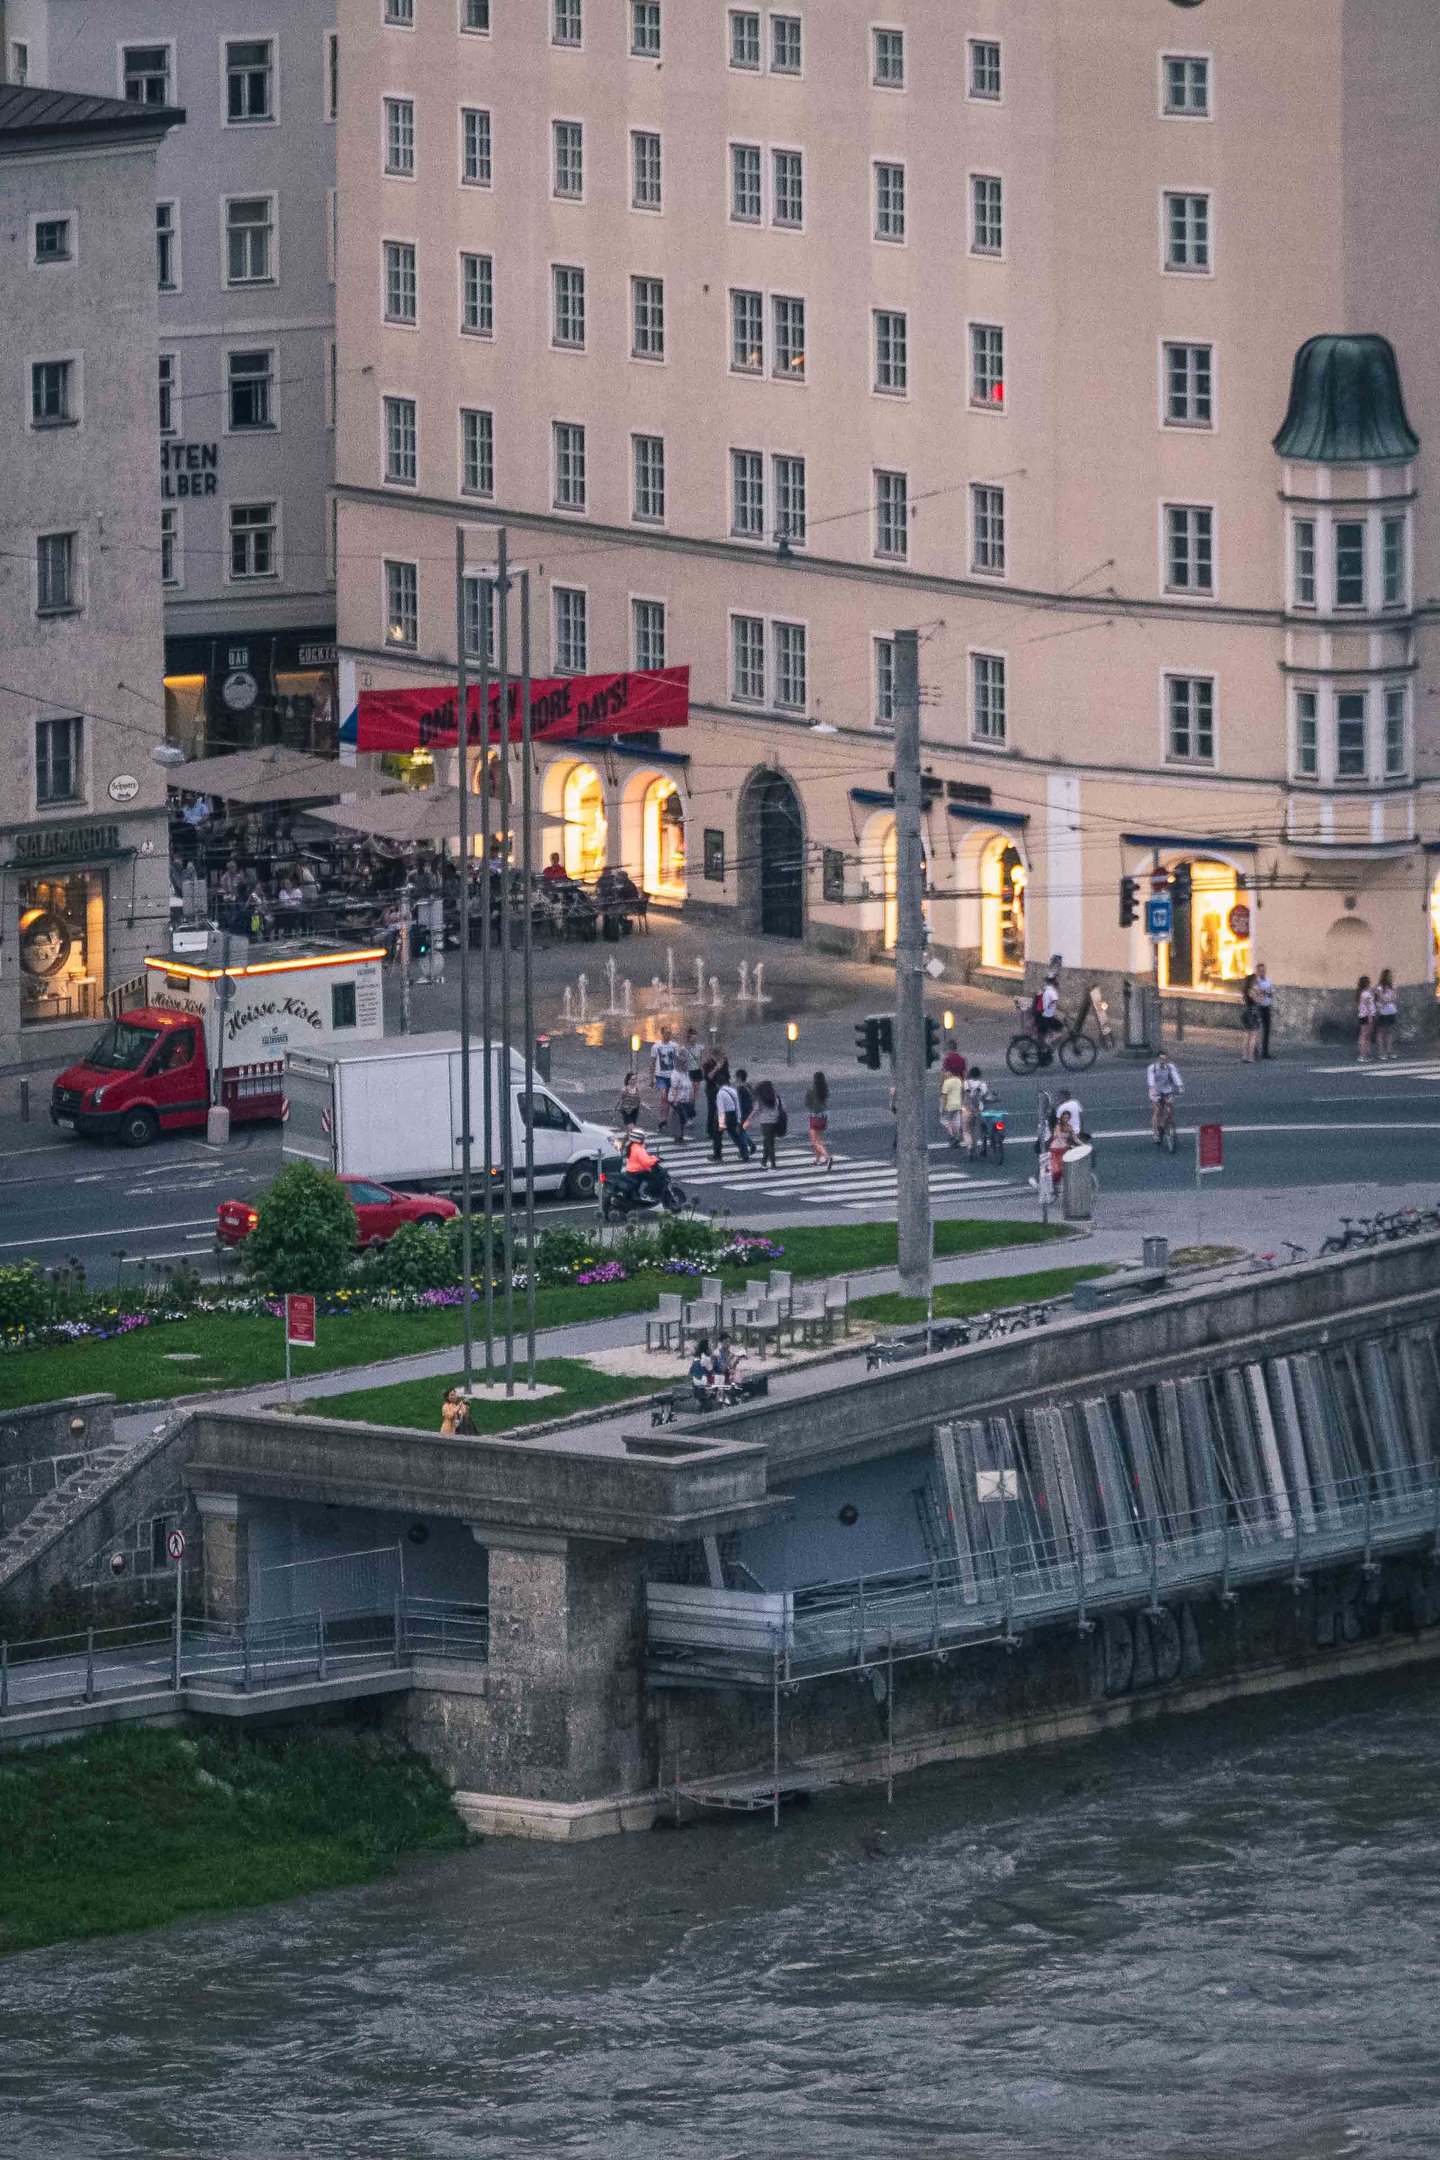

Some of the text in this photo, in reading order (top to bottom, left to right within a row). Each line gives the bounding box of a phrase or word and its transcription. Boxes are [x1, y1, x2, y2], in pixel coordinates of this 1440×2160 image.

[228, 650, 249, 666] BAR
[15, 825, 119, 858] SALAMANDER
[225, 1000, 276, 1041] Heisse
[276, 997, 323, 1030] Kiste
